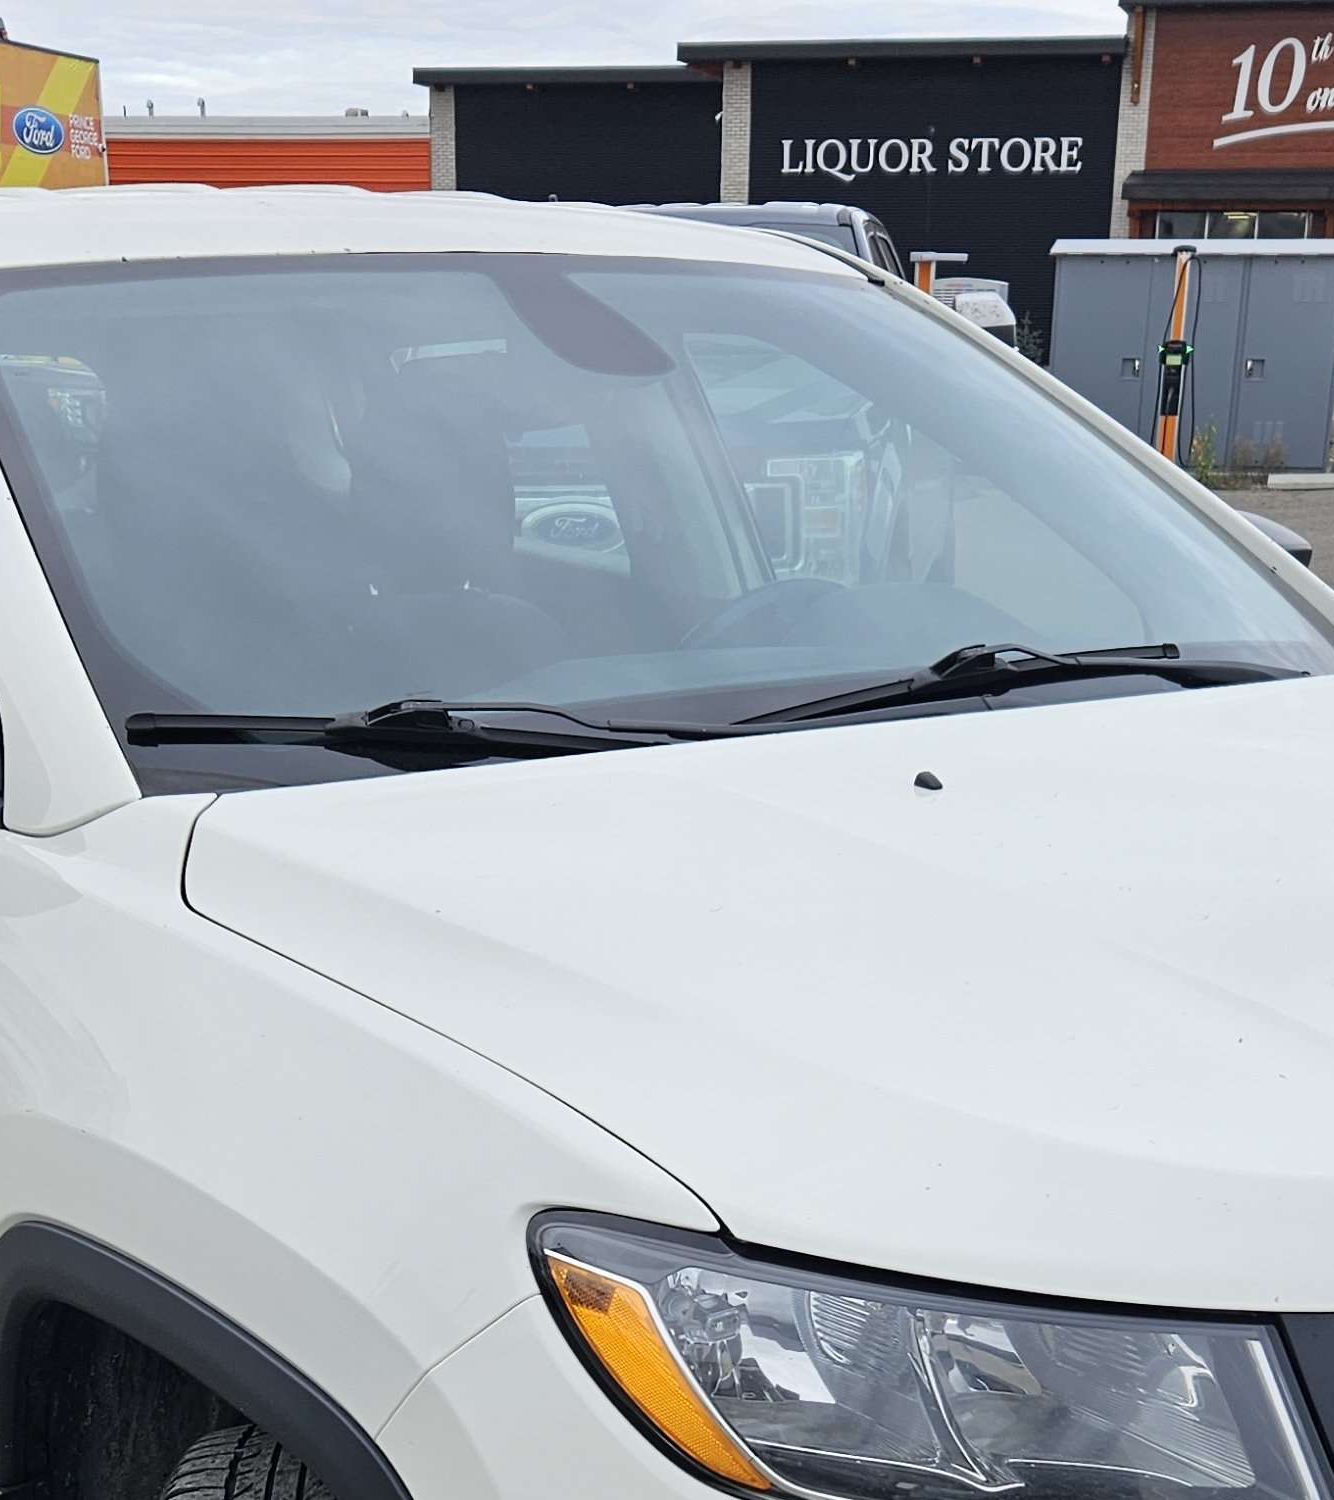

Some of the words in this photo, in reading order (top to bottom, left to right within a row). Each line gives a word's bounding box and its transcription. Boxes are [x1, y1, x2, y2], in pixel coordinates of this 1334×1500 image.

[21, 110, 57, 149] Ford
[781, 138, 938, 183] LIQUOR
[947, 136, 1084, 174] STORE
[549, 514, 601, 539] Ford
